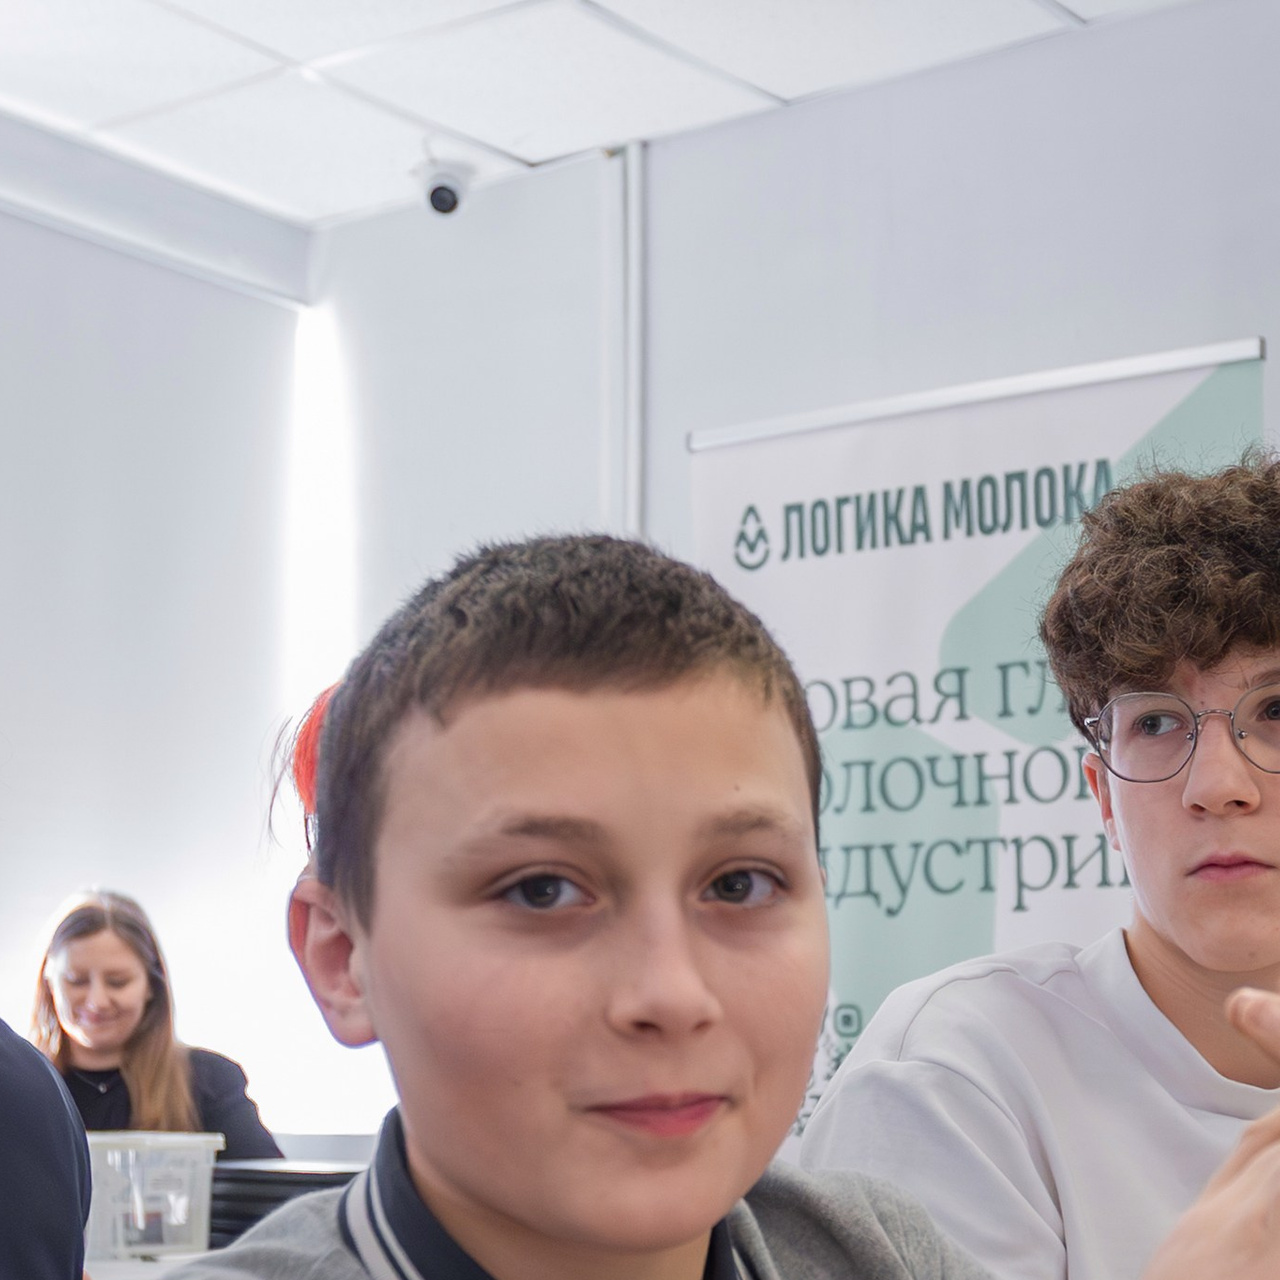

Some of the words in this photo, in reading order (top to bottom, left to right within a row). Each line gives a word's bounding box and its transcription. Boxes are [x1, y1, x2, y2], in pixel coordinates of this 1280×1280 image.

[781, 485, 933, 562] ЛОГИКА
[820, 745, 1094, 815] лочно
[820, 832, 1132, 918] дустри
